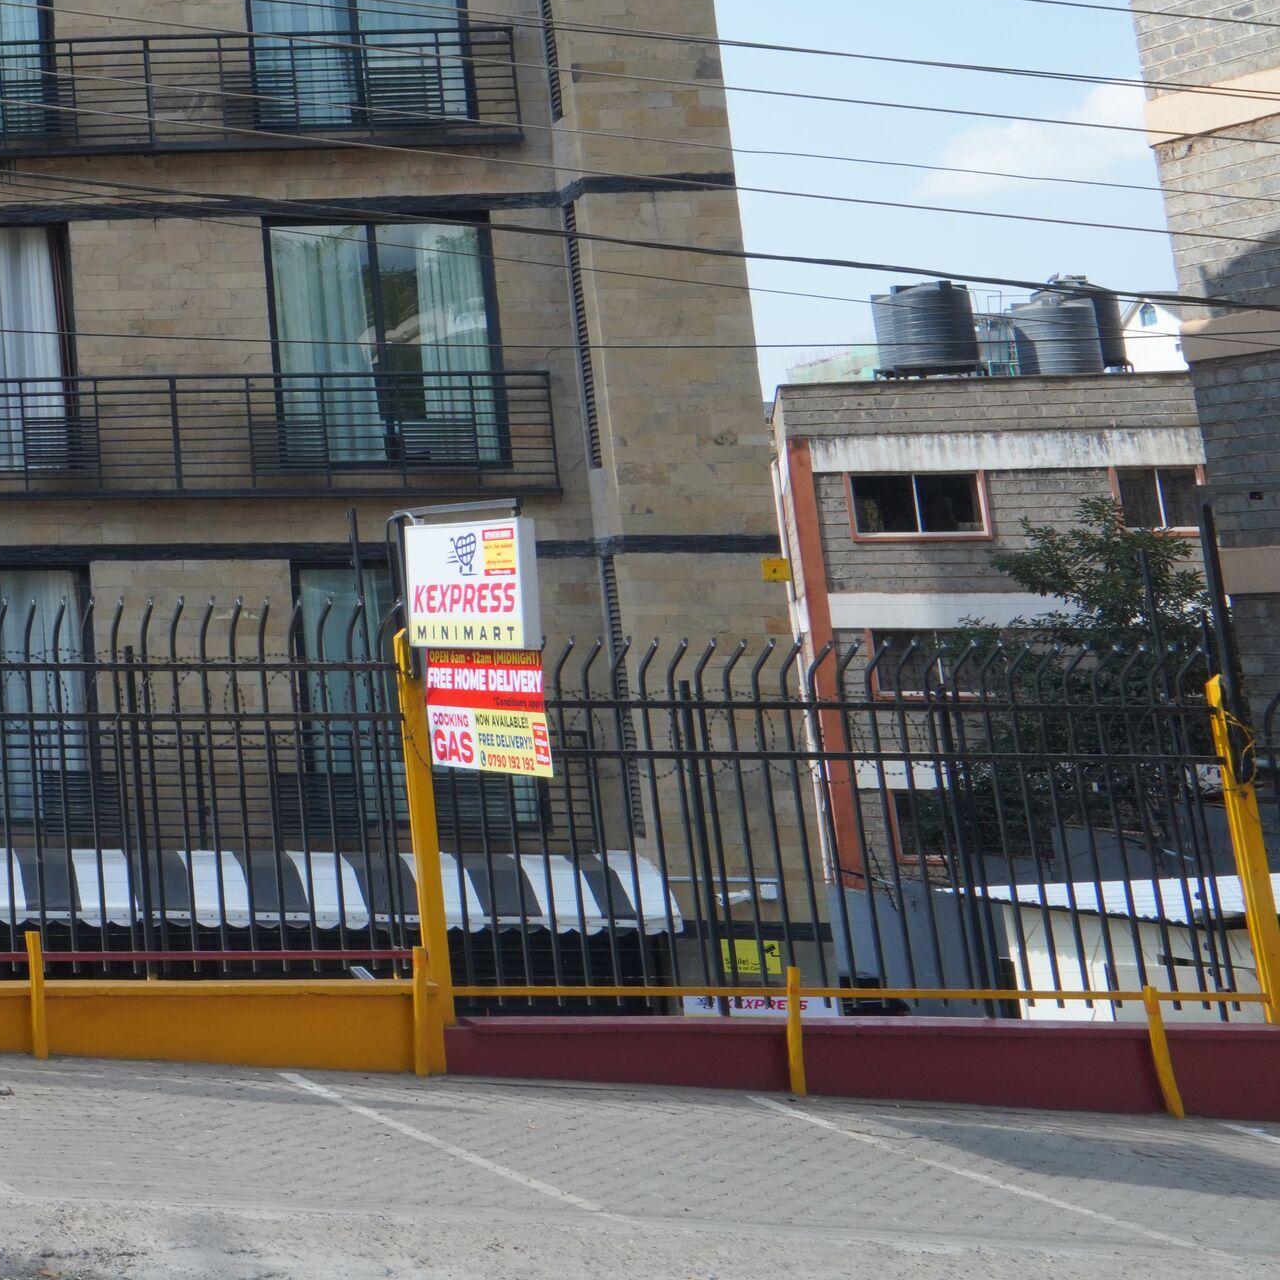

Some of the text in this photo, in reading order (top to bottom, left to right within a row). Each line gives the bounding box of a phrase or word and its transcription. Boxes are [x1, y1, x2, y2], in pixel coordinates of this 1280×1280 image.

[413, 582, 516, 613] KEXPRESS
[417, 626, 515, 641] MINIMART
[429, 651, 449, 663] OPEN
[450, 651, 466, 664] 6am
[472, 651, 492, 664] 12am
[493, 651, 540, 667] (MIDNIGHT)
[427, 667, 542, 693] FREE HOME DELIVERY
[432, 712, 469, 728] COOKING
[474, 713, 530, 729] NOW AVAILABLE!!
[433, 728, 474, 764] GAS
[478, 732, 534, 750] FREE DELIVERY!!
[487, 753, 535, 771] 0790 192 192
[725, 958, 749, 966] Sile!
